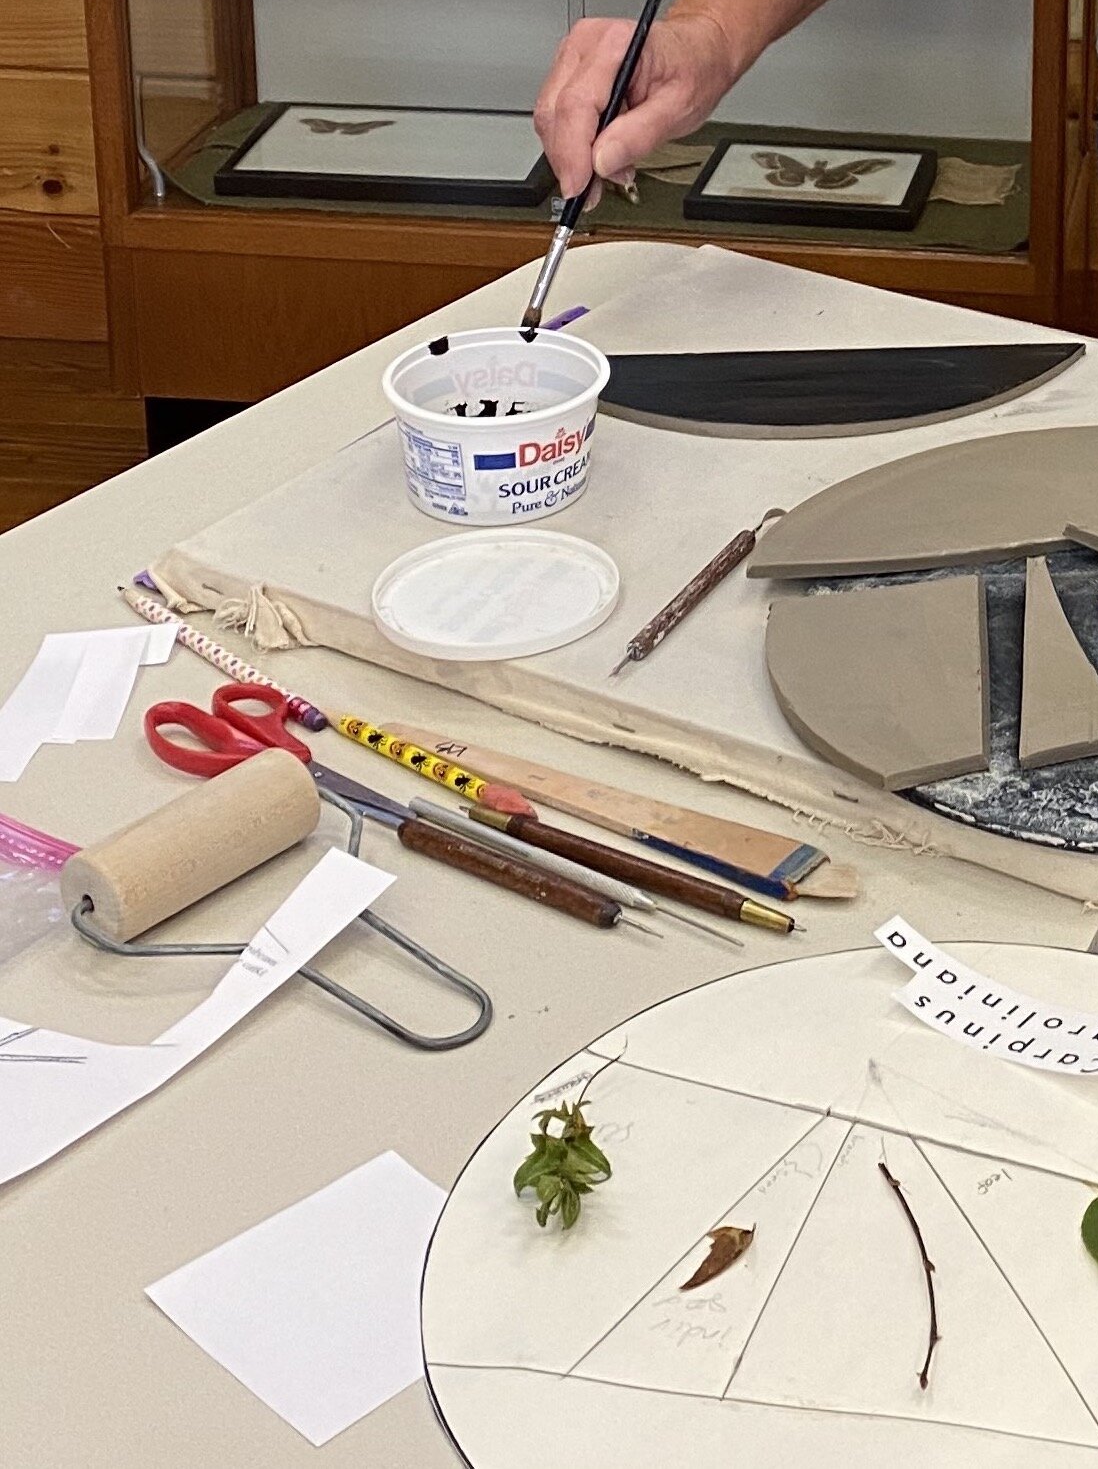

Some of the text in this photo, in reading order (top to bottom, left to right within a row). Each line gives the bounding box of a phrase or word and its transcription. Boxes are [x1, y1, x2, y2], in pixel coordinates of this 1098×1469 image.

[519, 426, 587, 467] Daisy
[499, 475, 550, 498] SOUR
[512, 500, 541, 514] Pure
[544, 490, 560, 507] &
